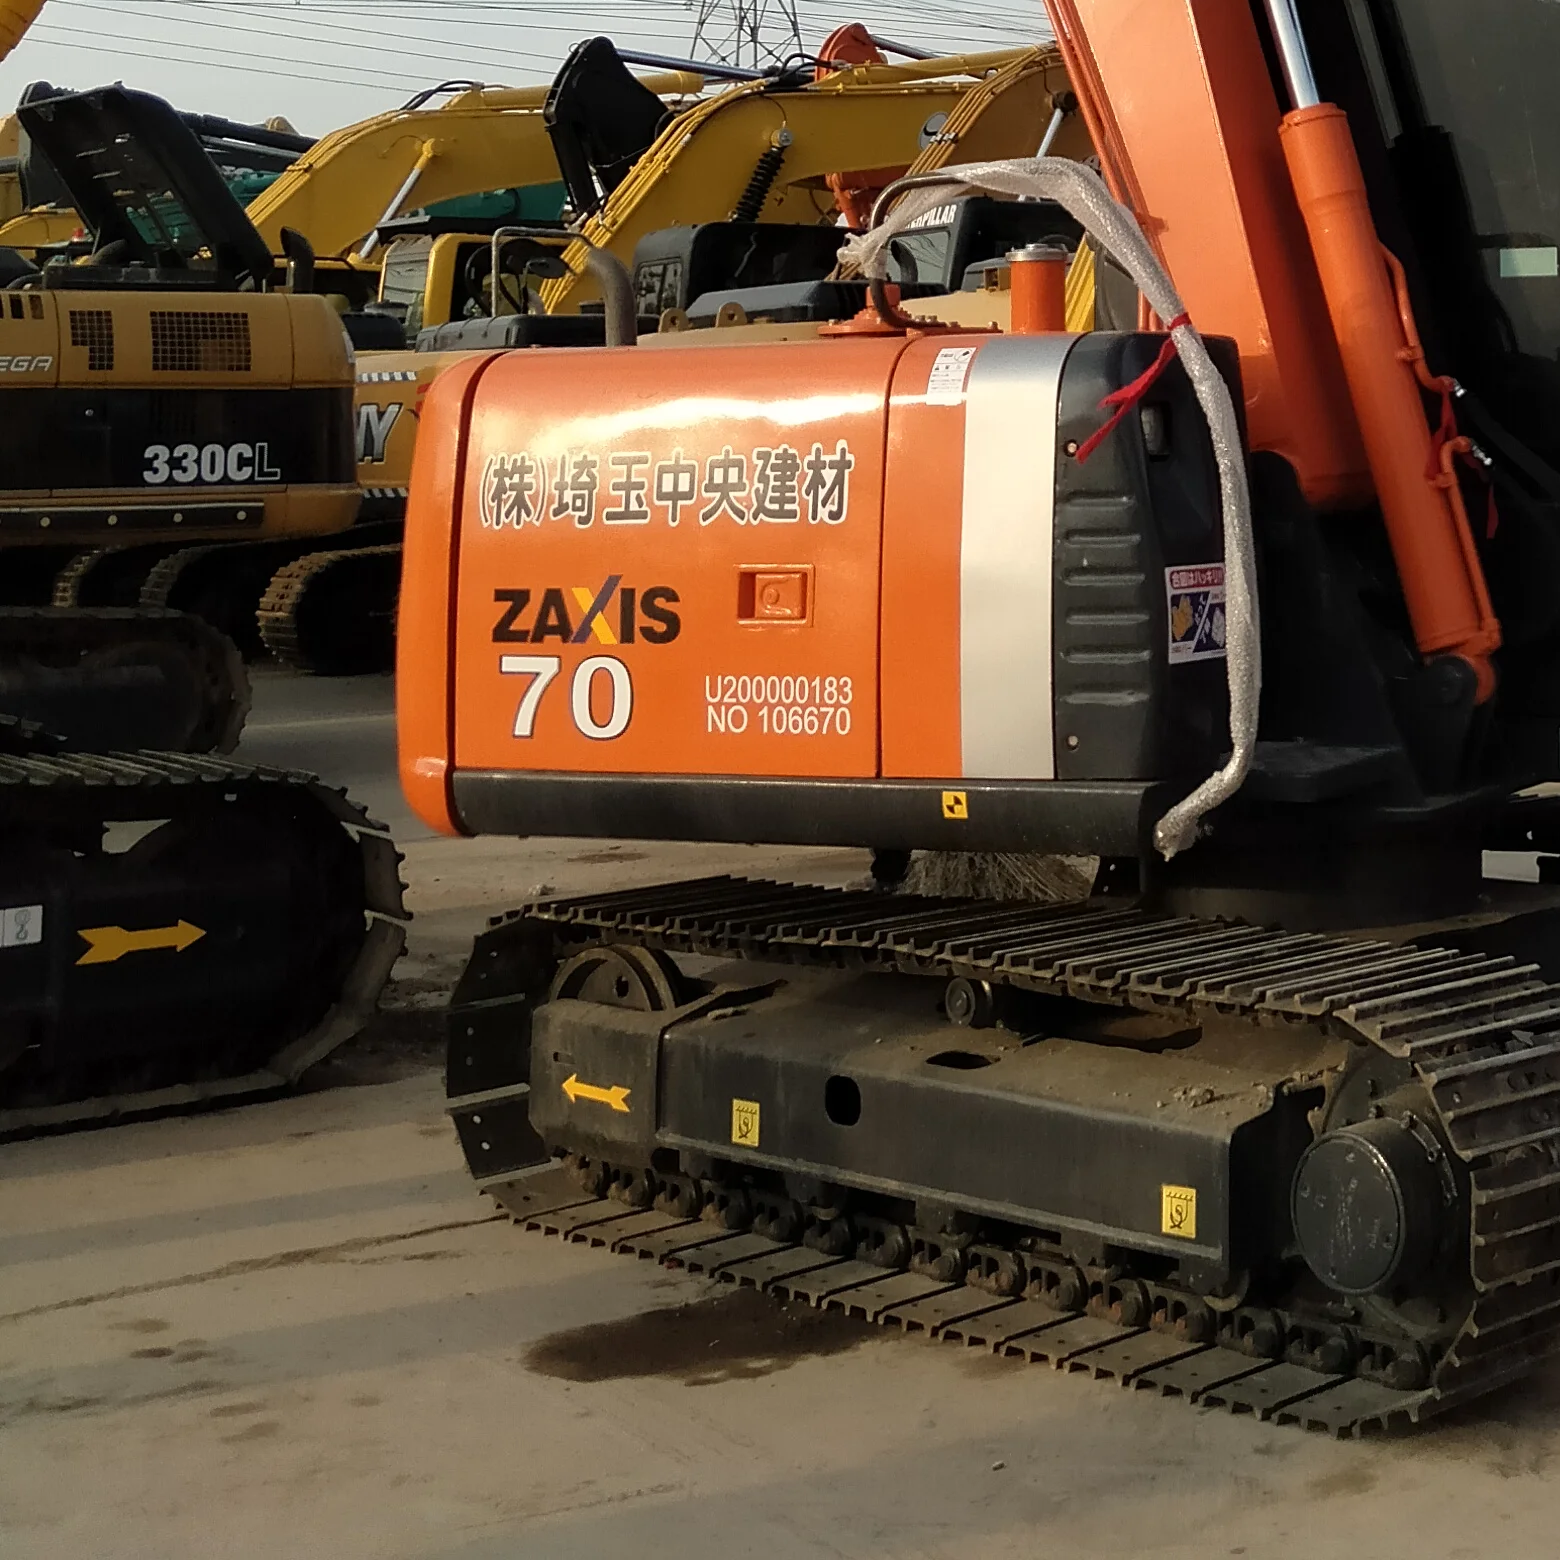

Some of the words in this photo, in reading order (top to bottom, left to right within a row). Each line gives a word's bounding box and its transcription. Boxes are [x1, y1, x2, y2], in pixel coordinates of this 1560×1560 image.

[143, 442, 281, 483] 330CL
[491, 574, 682, 645] ZAXIS
[498, 654, 634, 741] 70
[704, 675, 853, 705] U200000183
[707, 706, 748, 733] NO
[757, 705, 851, 735] 106670
